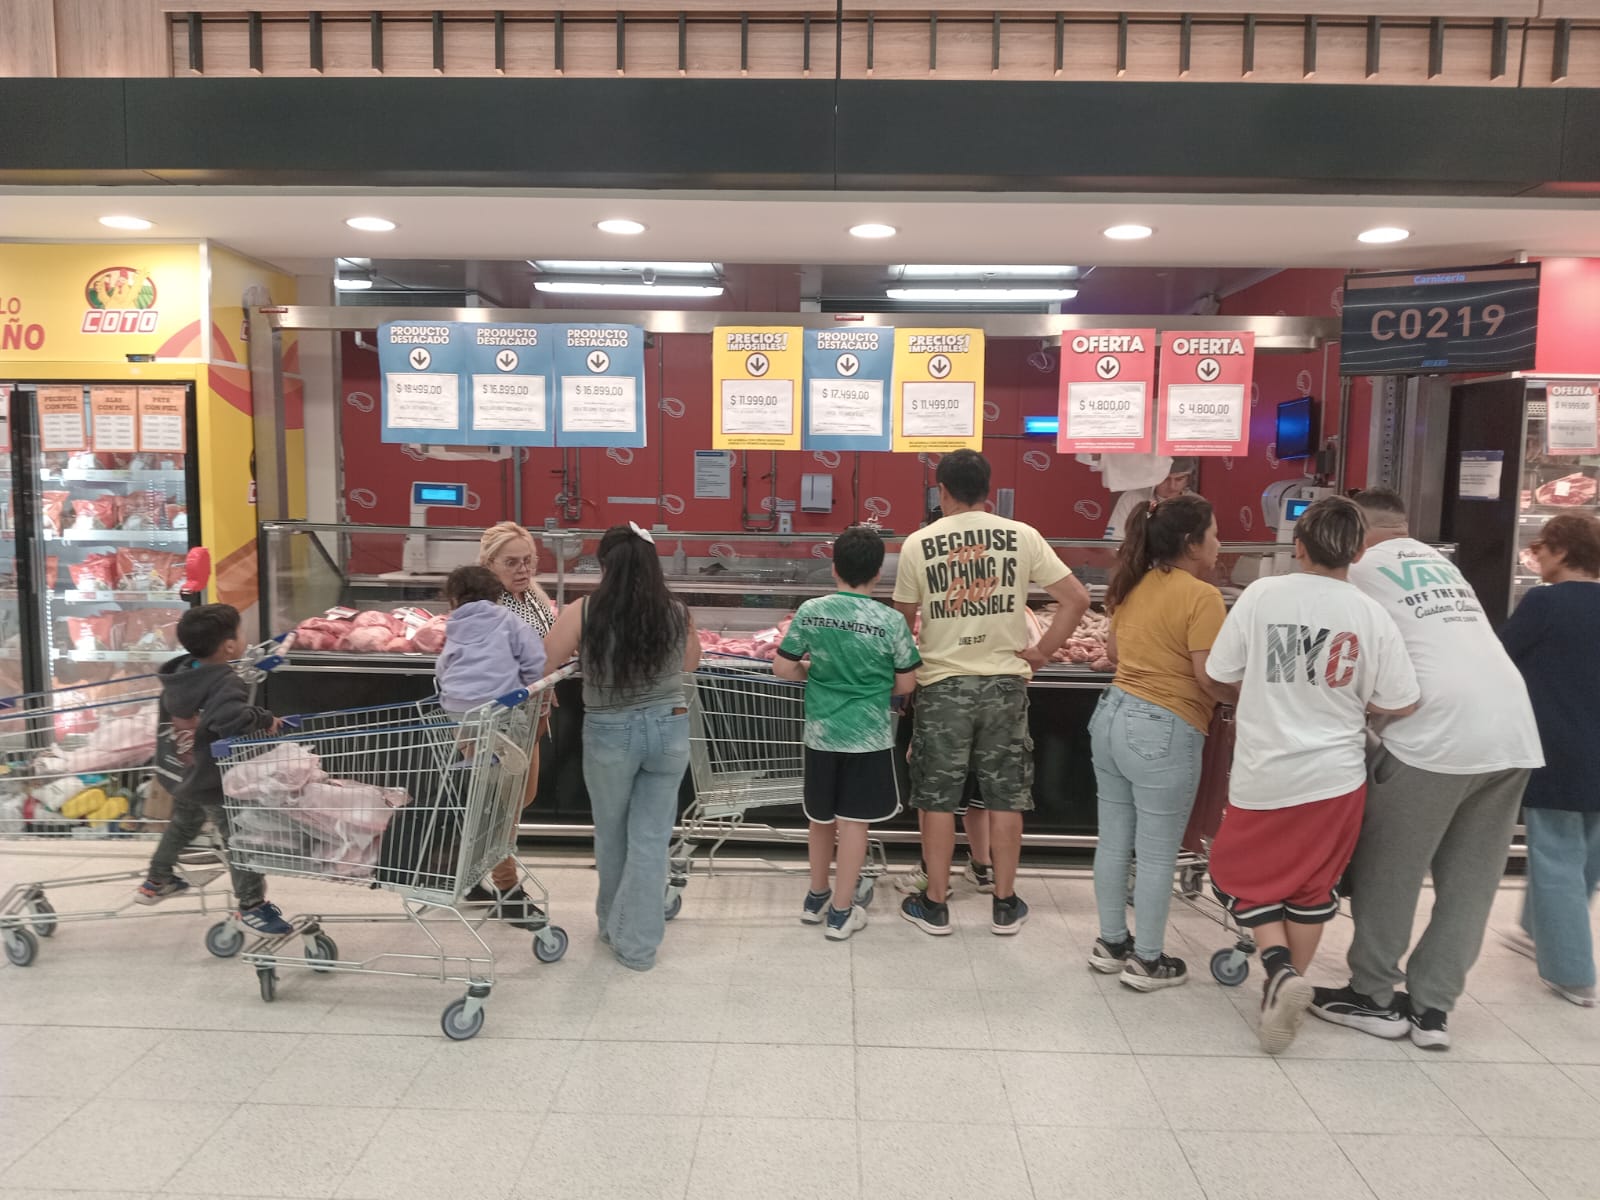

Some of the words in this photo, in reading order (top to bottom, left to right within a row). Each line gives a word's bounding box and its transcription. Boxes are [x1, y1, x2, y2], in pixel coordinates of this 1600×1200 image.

[81, 311, 159, 333] COTO
[1371, 304, 1506, 341] C0219
[390, 327, 449, 336] PRODUCTO
[477, 329, 537, 337] PRODUCTO
[567, 330, 628, 338] PRODUCTO
[817, 332, 878, 341] PRODUCTO
[390, 336, 449, 344] DESTACADO
[477, 337, 537, 346] DESTACADO
[567, 338, 628, 347] DESTACADO
[817, 341, 878, 350] DESTACADO
[1072, 336, 1145, 353] OFERTA
[1173, 338, 1245, 355] OFERTA
[831, 389, 870, 401] 17.499,00
[1552, 386, 1593, 396] OFERTA
[921, 399, 960, 410] 11.499,00
[1079, 399, 1086, 411] $
[1089, 400, 1131, 412] 4.800,00
[1179, 403, 1185, 414] $
[1189, 404, 1230, 416] 4.800,00
[921, 529, 1017, 560] BECAUSE
[926, 557, 996, 594] NOTHING
[1002, 557, 1017, 587] IS
[945, 576, 999, 612] GOD
[1432, 588, 1455, 599] THE
[930, 595, 1015, 619] IMPOSSIBLE
[1415, 604, 1455, 619] Custom
[801, 616, 886, 638] ENTRENAMIENTO
[1266, 624, 1359, 688] NYC
